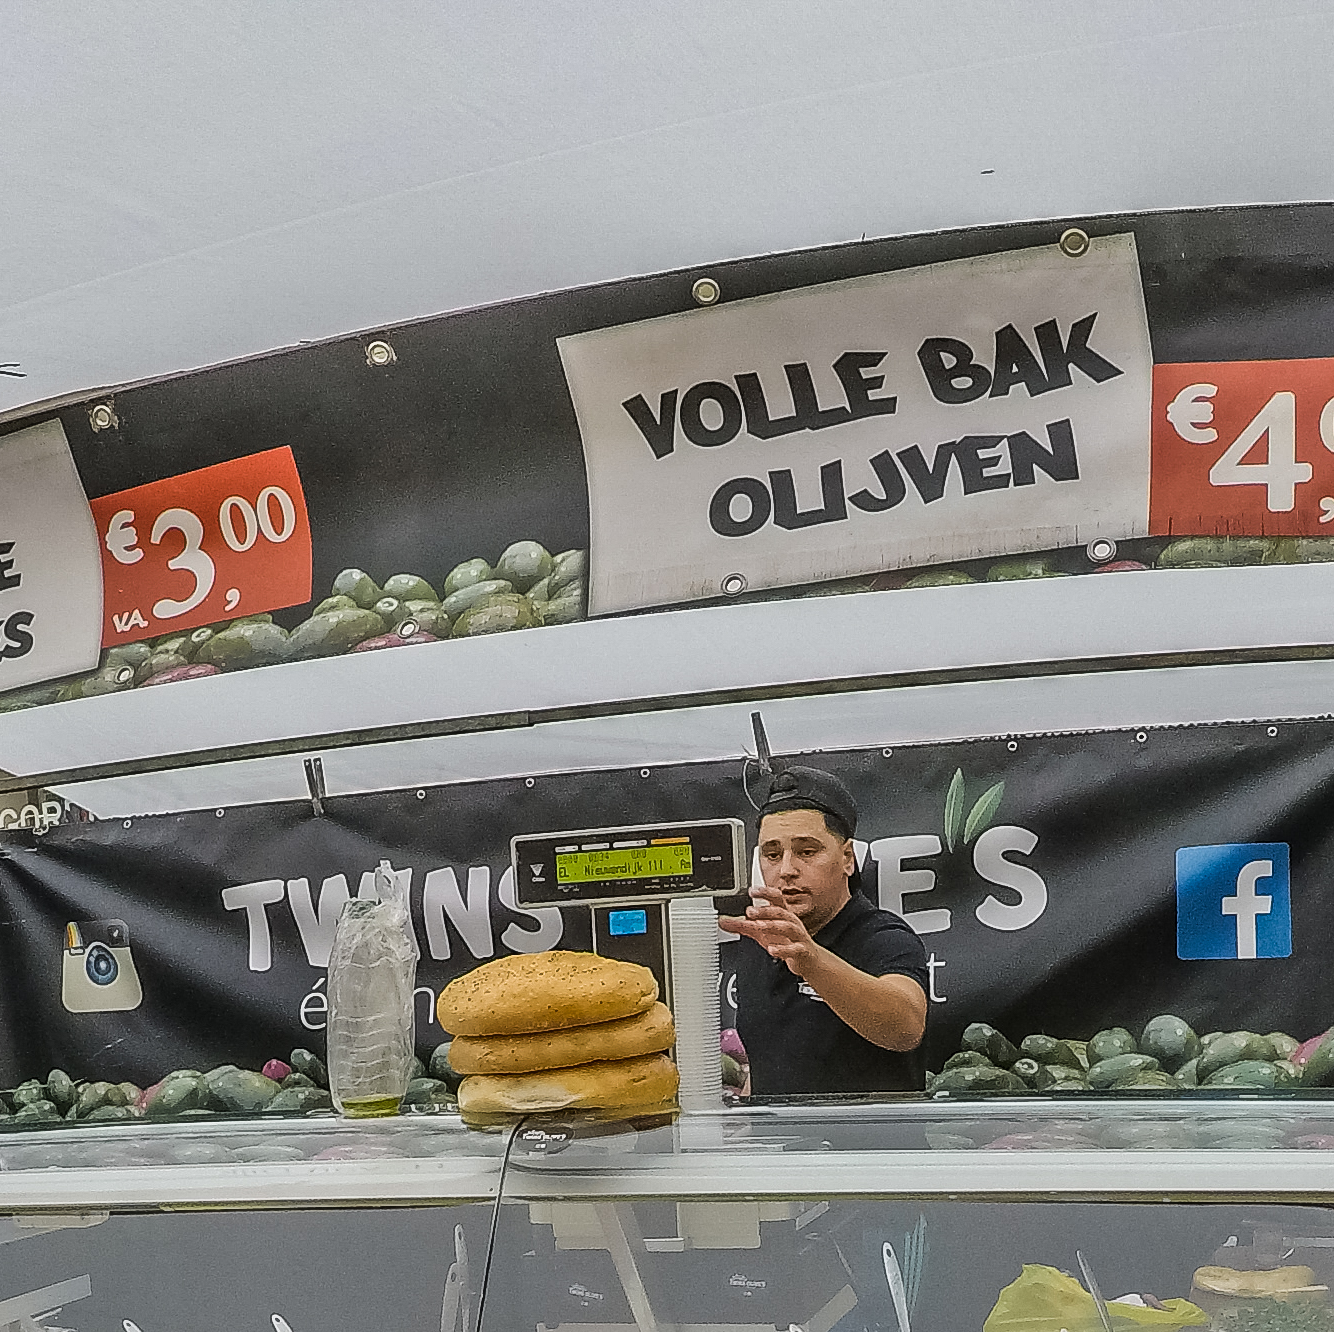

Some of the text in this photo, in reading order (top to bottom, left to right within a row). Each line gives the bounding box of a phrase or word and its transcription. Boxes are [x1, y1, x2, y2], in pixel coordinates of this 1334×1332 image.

[621, 311, 1124, 459] VOLLE BAK
[709, 417, 1081, 537] OLIJVEN
